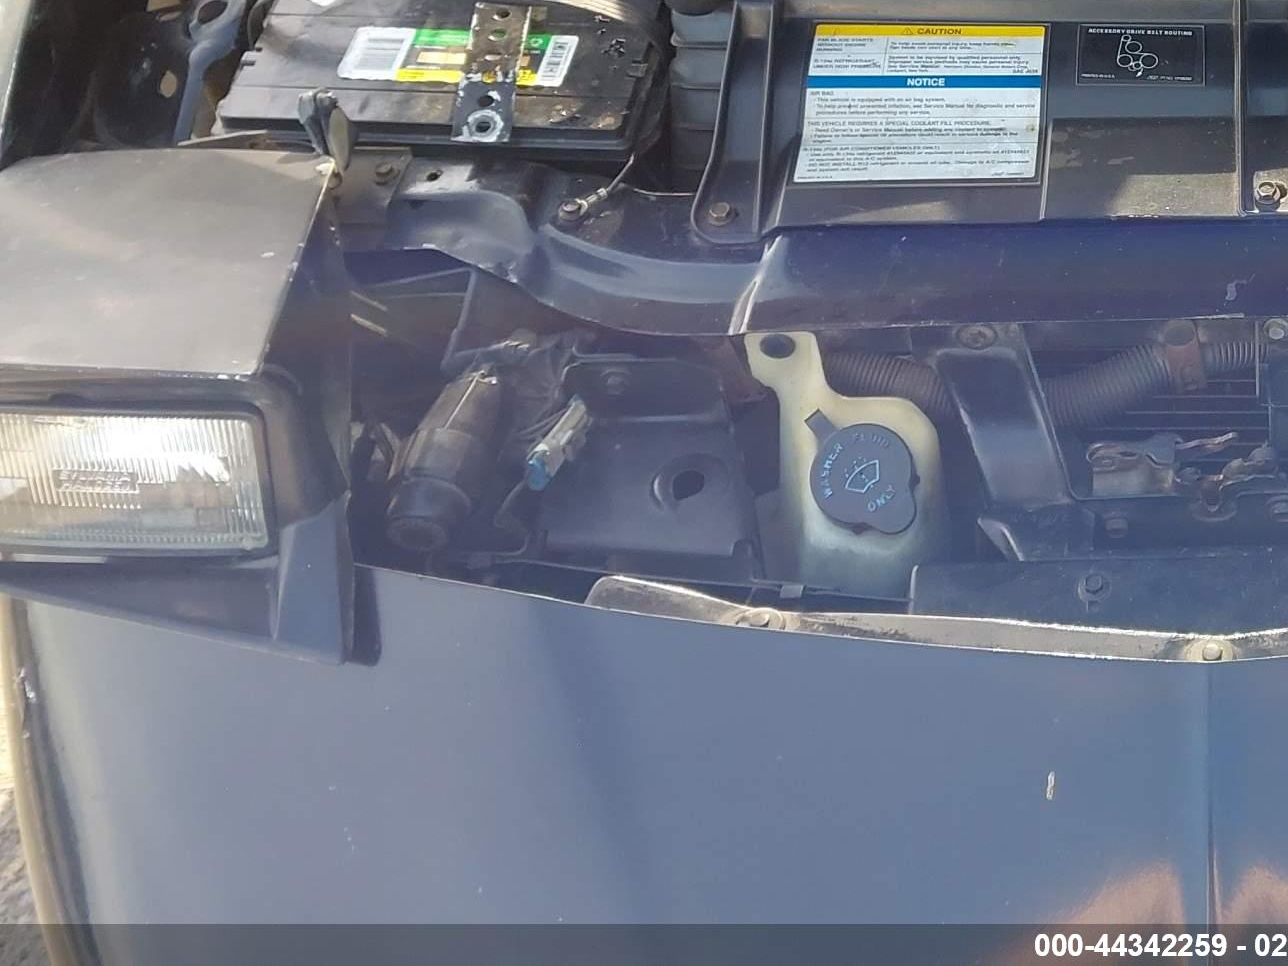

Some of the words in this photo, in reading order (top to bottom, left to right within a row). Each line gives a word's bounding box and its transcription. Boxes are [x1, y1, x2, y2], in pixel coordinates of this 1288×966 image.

[907, 77, 945, 87] NOTICE
[852, 433, 890, 448] FLUID
[820, 442, 844, 499] WASHER
[867, 484, 896, 512] ONLY
